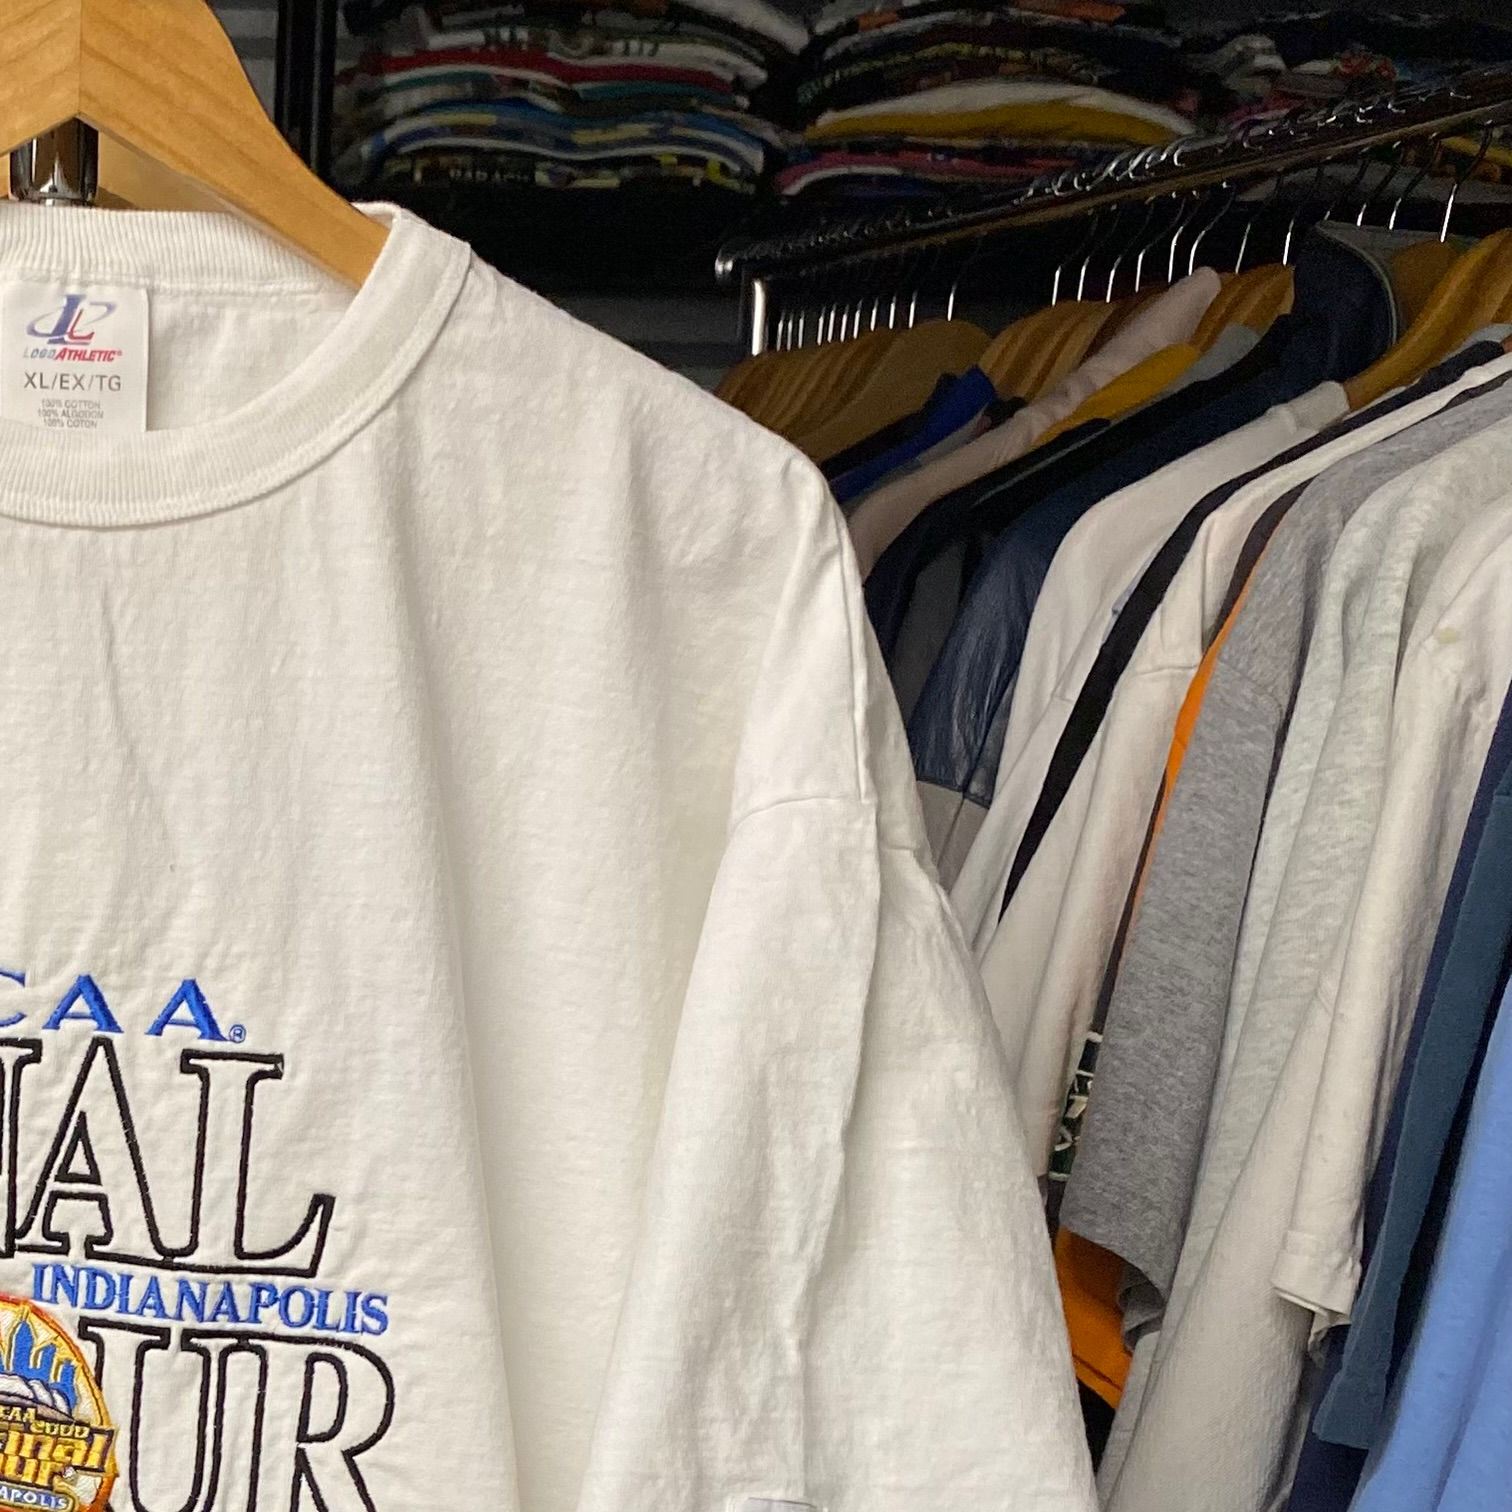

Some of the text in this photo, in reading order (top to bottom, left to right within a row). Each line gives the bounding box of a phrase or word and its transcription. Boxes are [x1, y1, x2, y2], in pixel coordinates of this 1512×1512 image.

[24, 372, 121, 392] XL/EX/TG
[64, 399, 101, 410] COTTON
[32, 1263, 389, 1335] INDIANAPOLIS
